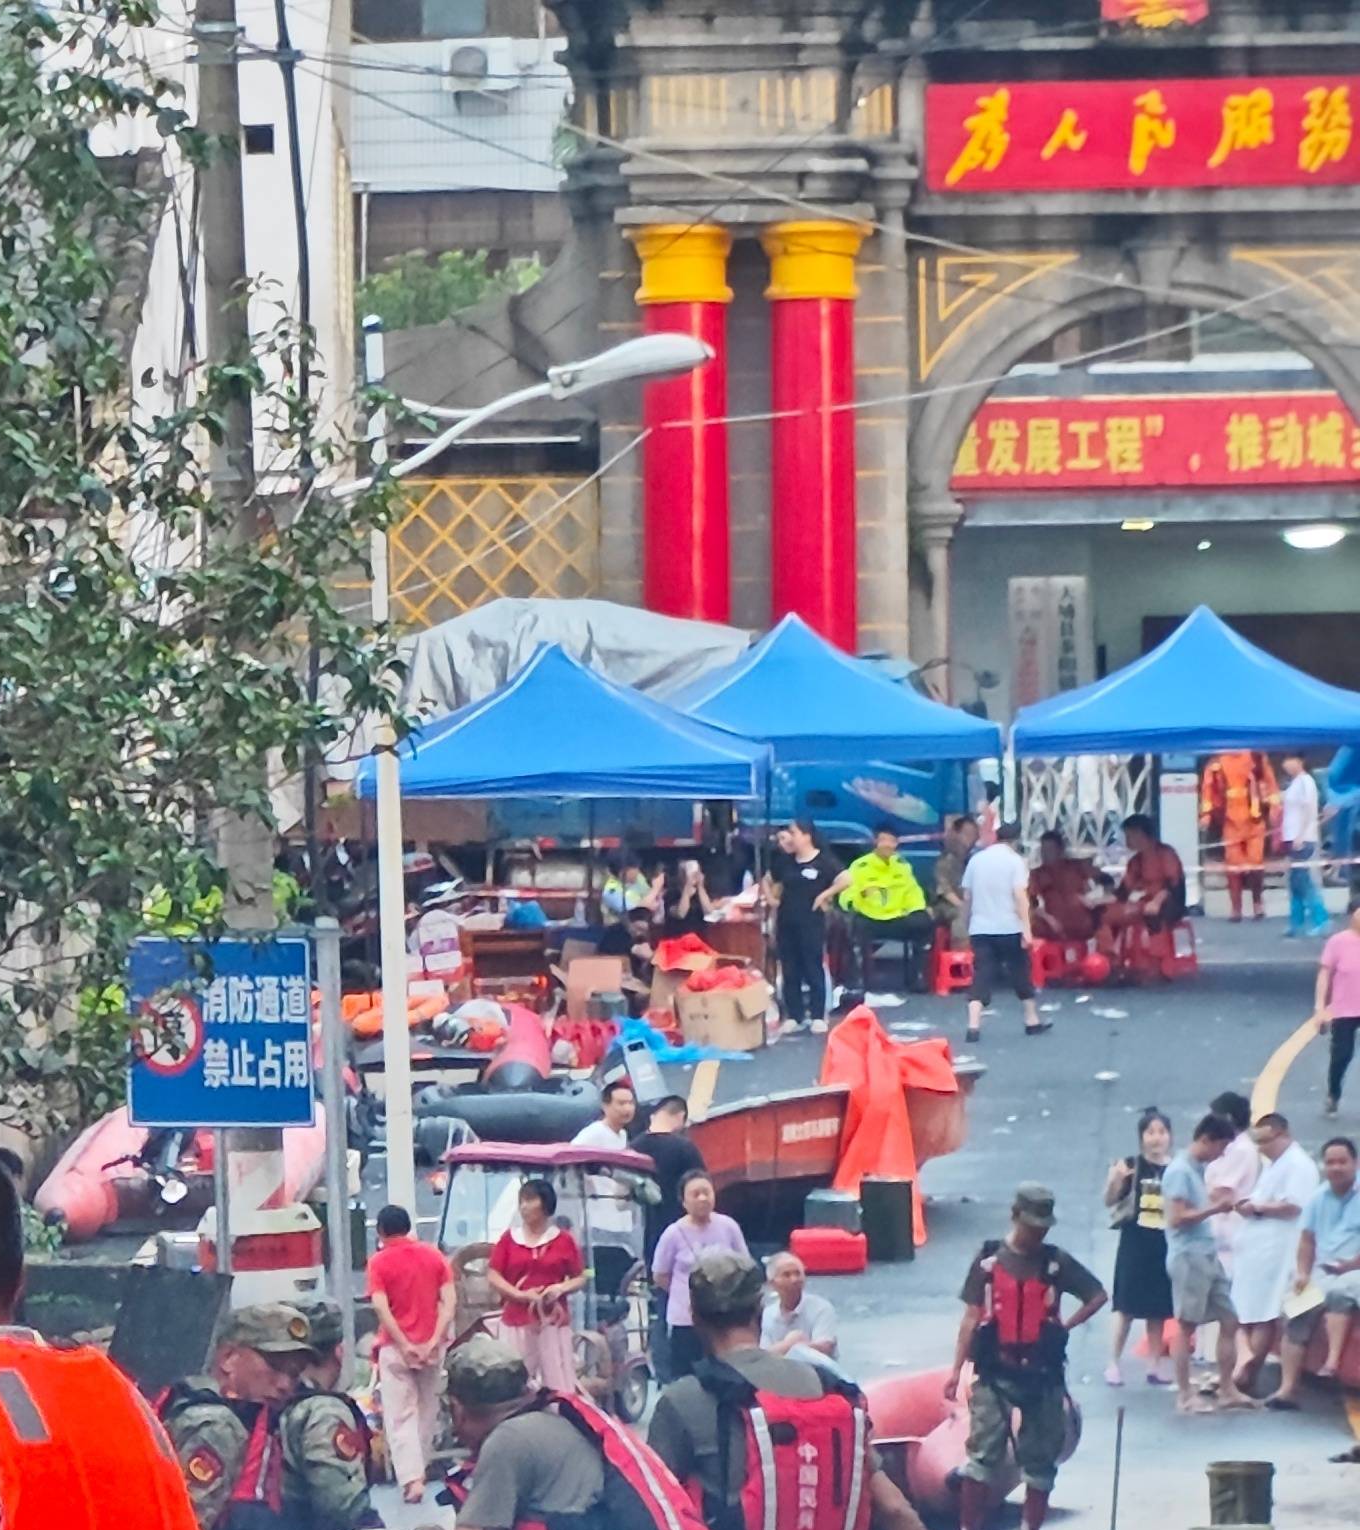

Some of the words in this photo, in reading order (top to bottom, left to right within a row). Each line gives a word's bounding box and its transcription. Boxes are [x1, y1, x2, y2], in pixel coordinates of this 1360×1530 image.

[202, 975, 306, 1024] 消防通道
[203, 1038, 309, 1089] 禁止占用
